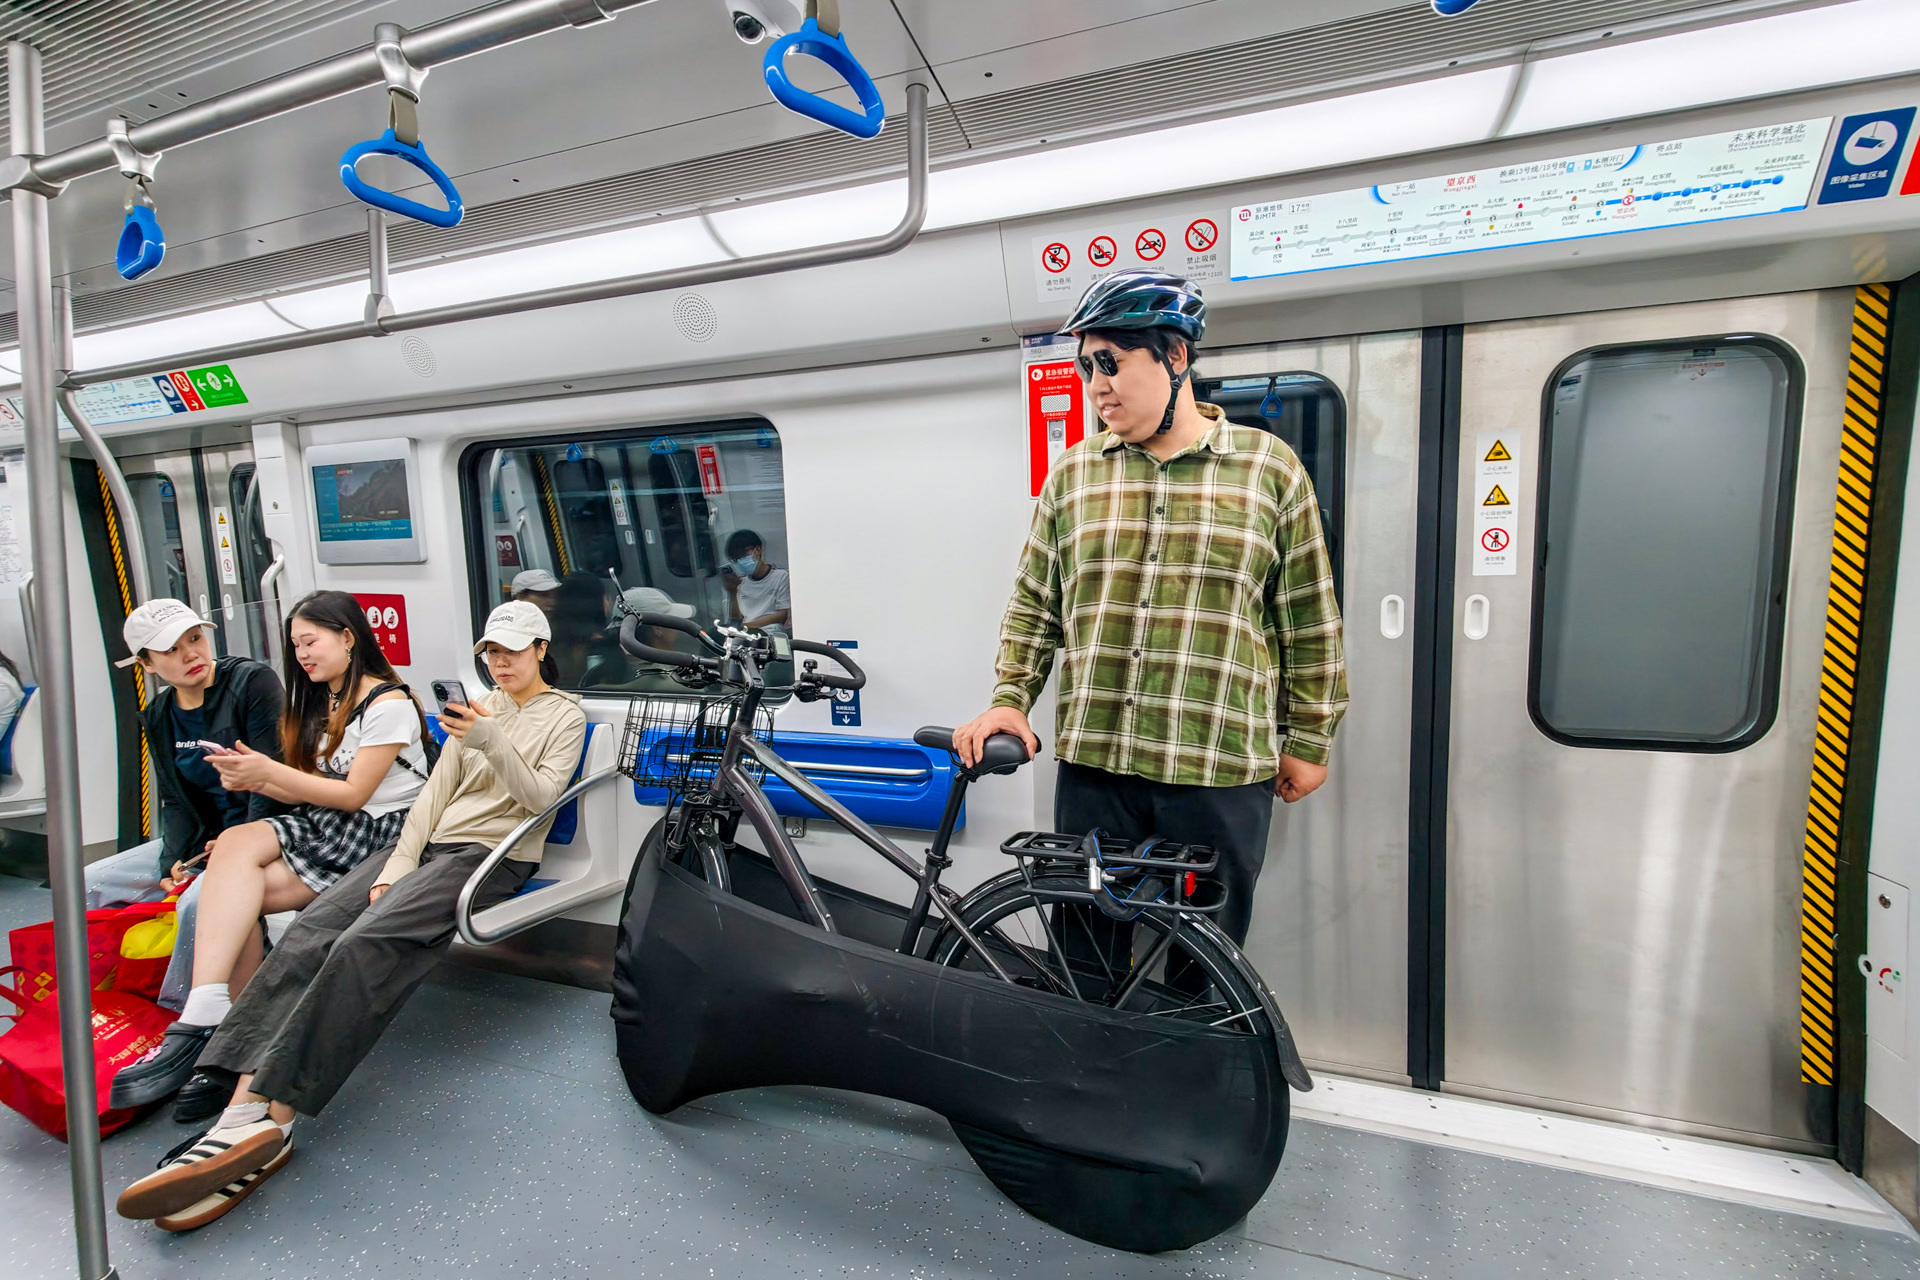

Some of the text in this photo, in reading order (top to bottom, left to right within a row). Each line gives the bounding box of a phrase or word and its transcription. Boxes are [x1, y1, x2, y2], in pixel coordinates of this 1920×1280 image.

[1731, 124, 1806, 142] 未来科学城北
[1656, 143, 1683, 152] 终点站
[1594, 154, 1624, 165] 本侧开门
[1446, 175, 1476, 187] 望京西
[1395, 183, 1416, 191] 下一站
[1186, 254, 1217, 264] 禁止吸烟
[1194, 263, 1215, 271] Smoking
[1045, 277, 1072, 286] 请勿悬吊
